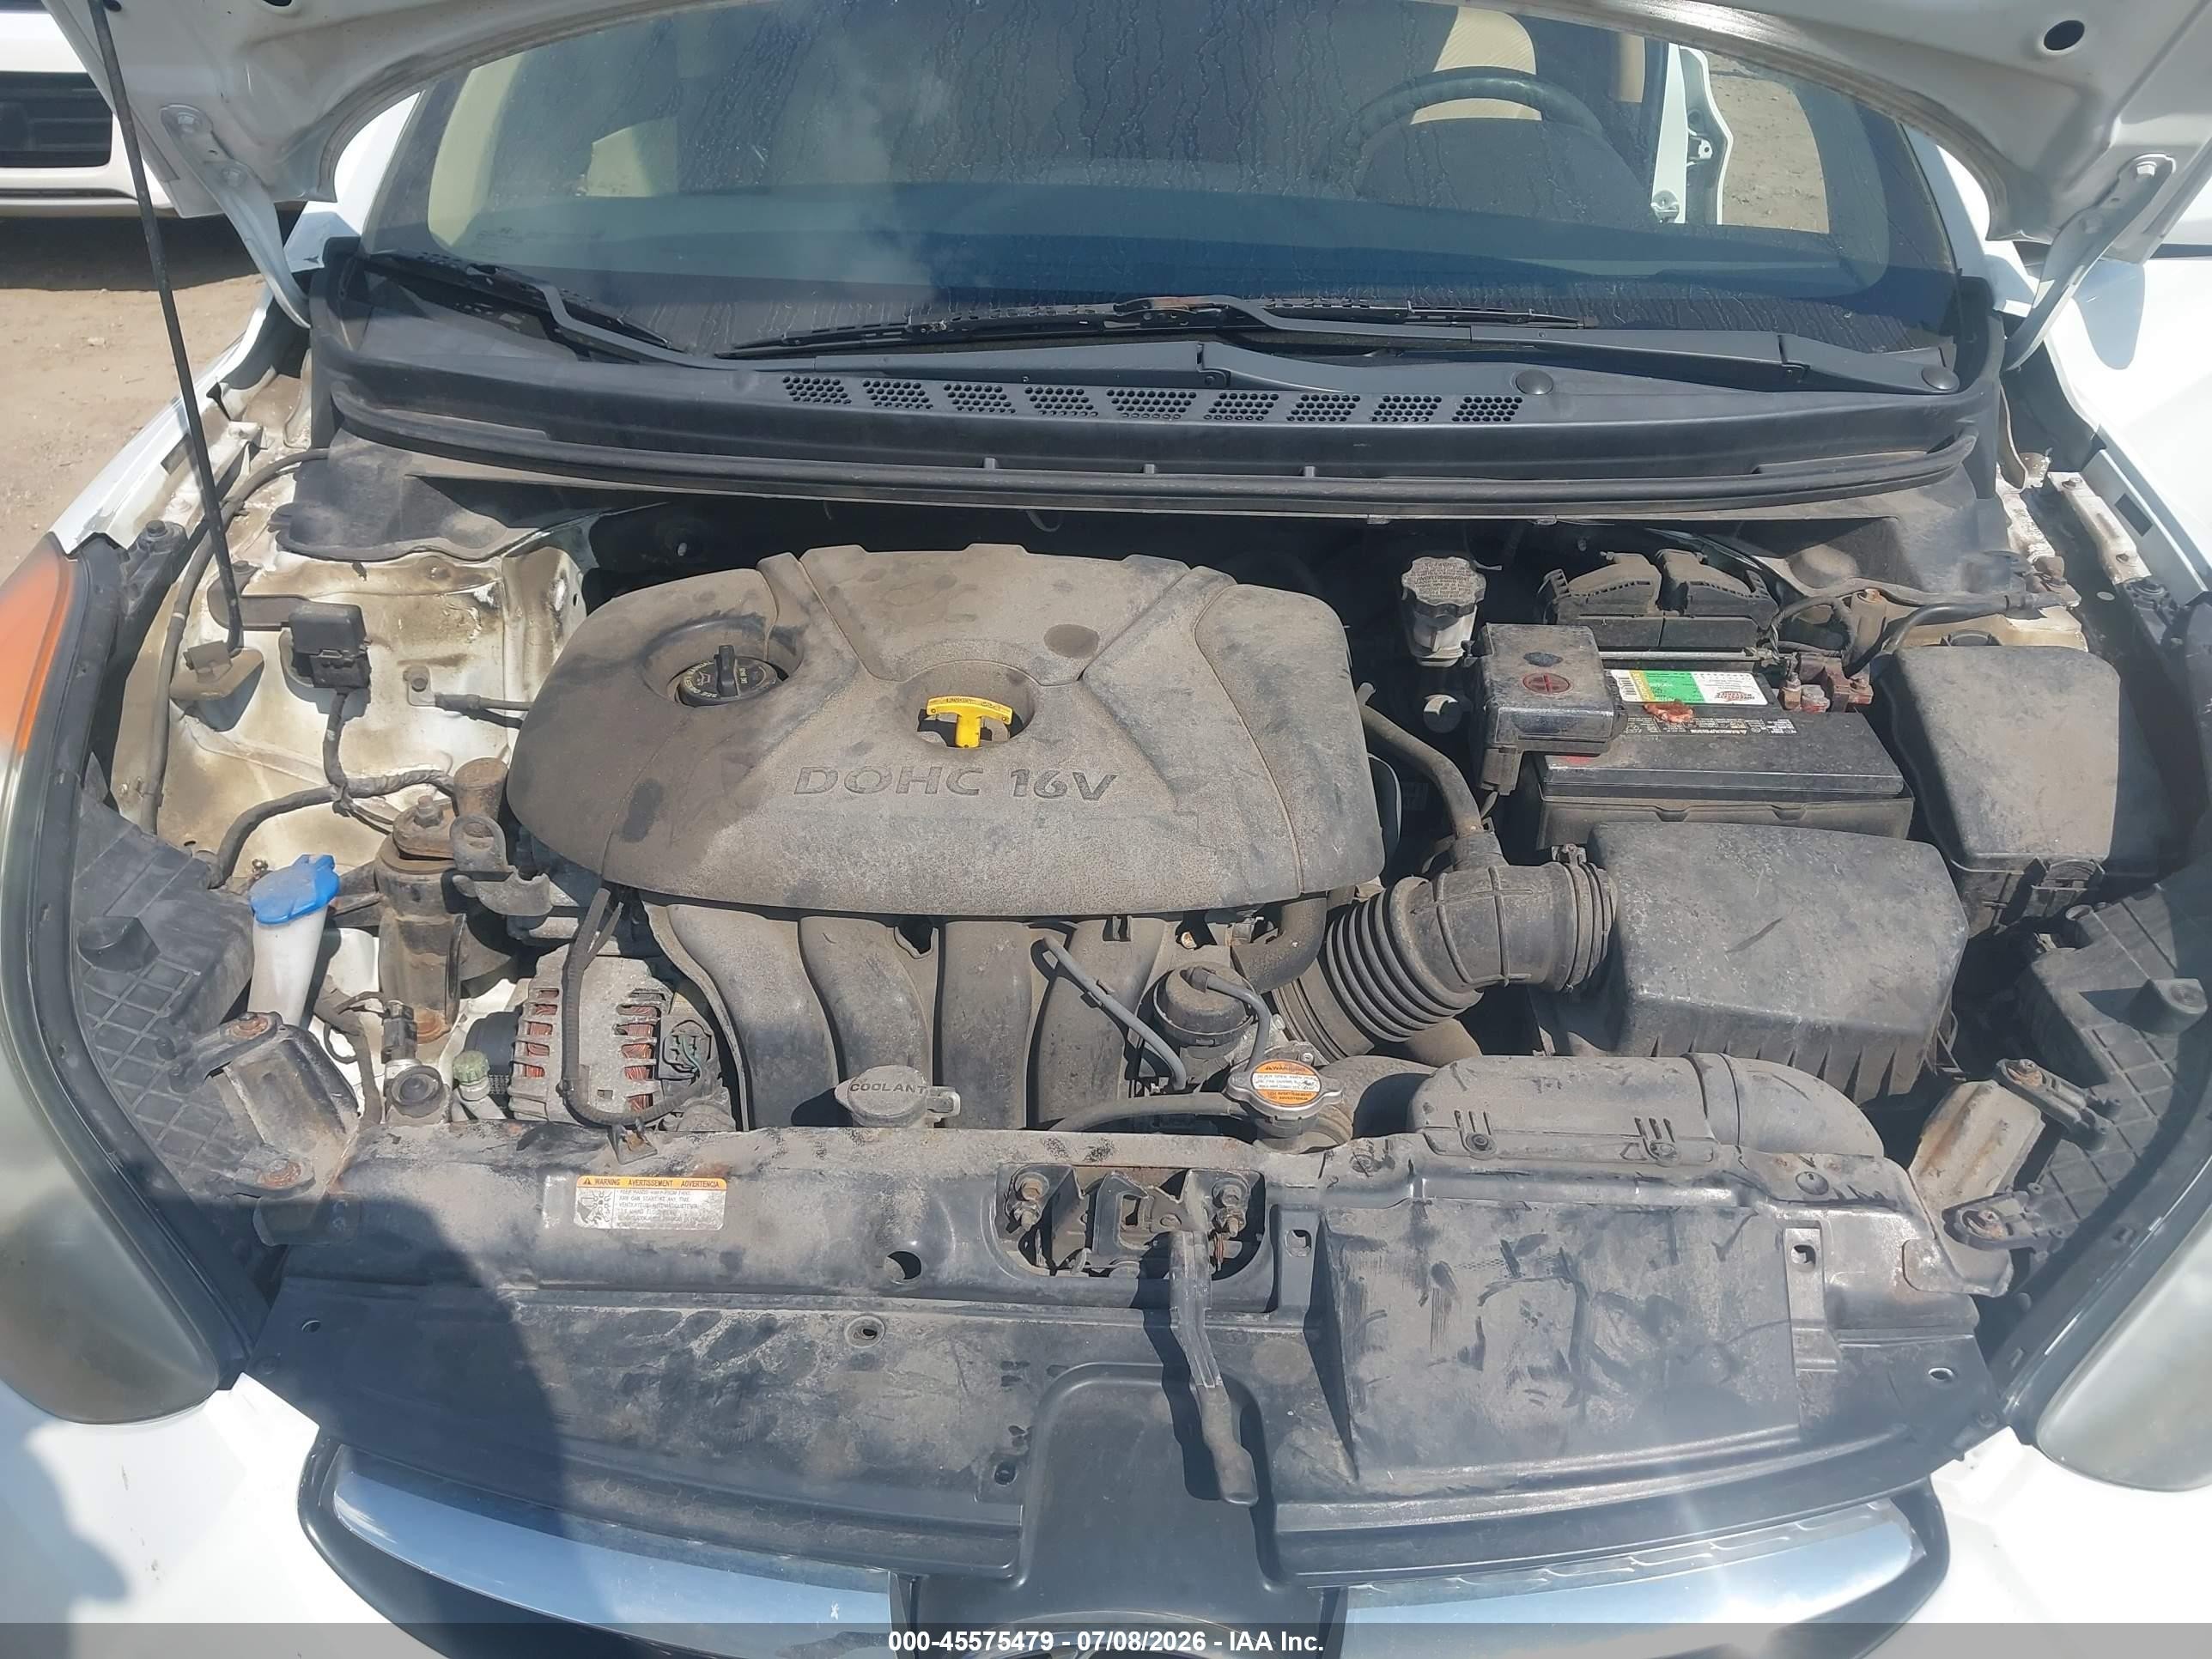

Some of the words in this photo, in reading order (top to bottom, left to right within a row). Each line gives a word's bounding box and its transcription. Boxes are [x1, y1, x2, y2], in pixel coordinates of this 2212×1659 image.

[793, 766, 984, 796] DOHC
[1010, 769, 1118, 801] 16V
[849, 1083, 927, 1095] COOLANT
[628, 1179, 673, 1188] AVERTISSEMENT
